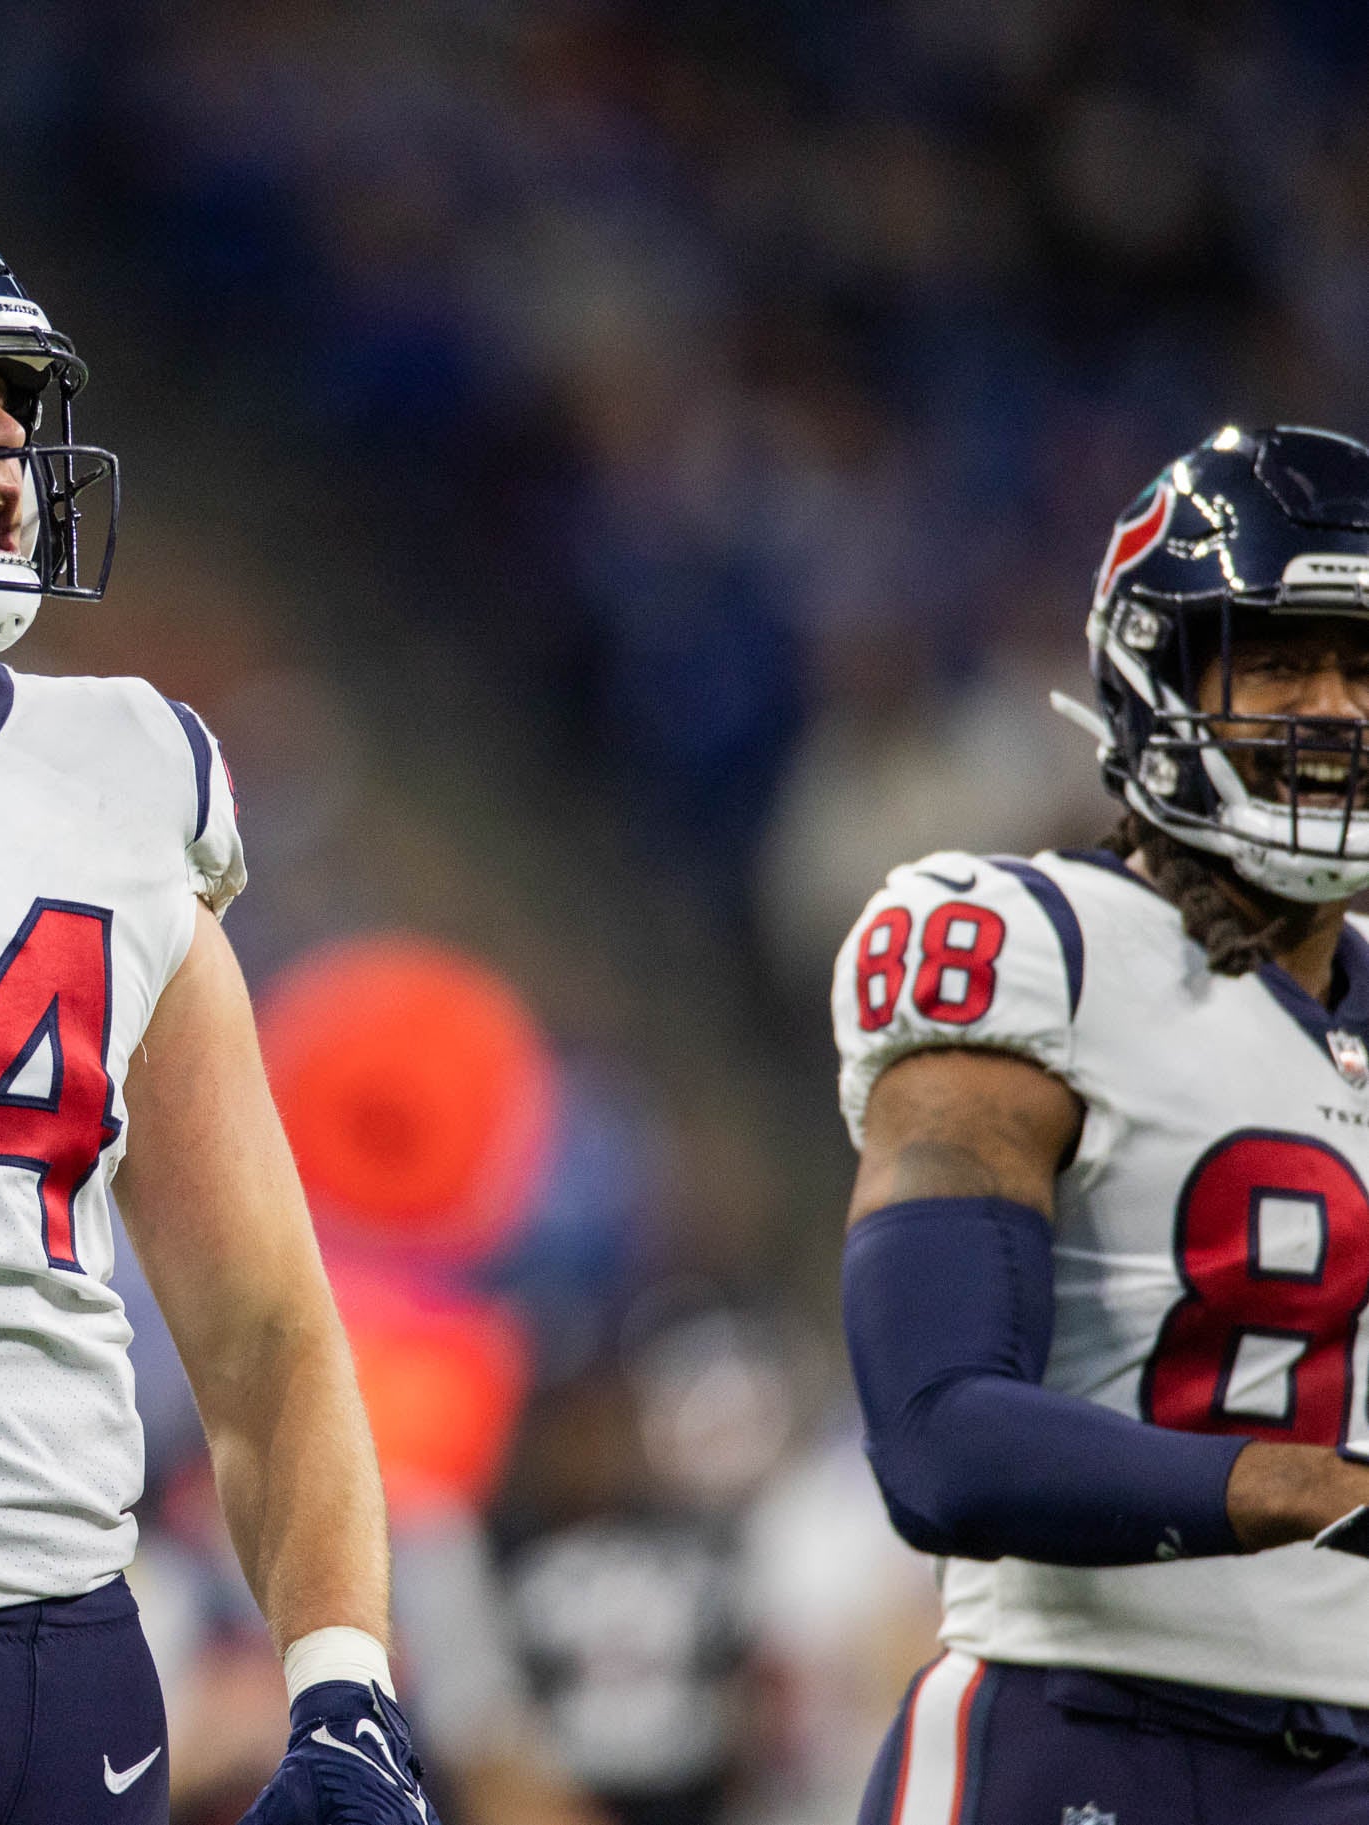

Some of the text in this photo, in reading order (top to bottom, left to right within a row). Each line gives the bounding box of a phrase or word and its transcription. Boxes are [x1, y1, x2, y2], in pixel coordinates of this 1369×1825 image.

[856, 902, 1007, 1032] 88
[1315, 1104, 1369, 1126] TEX
[1138, 1126, 1369, 1449] 8
